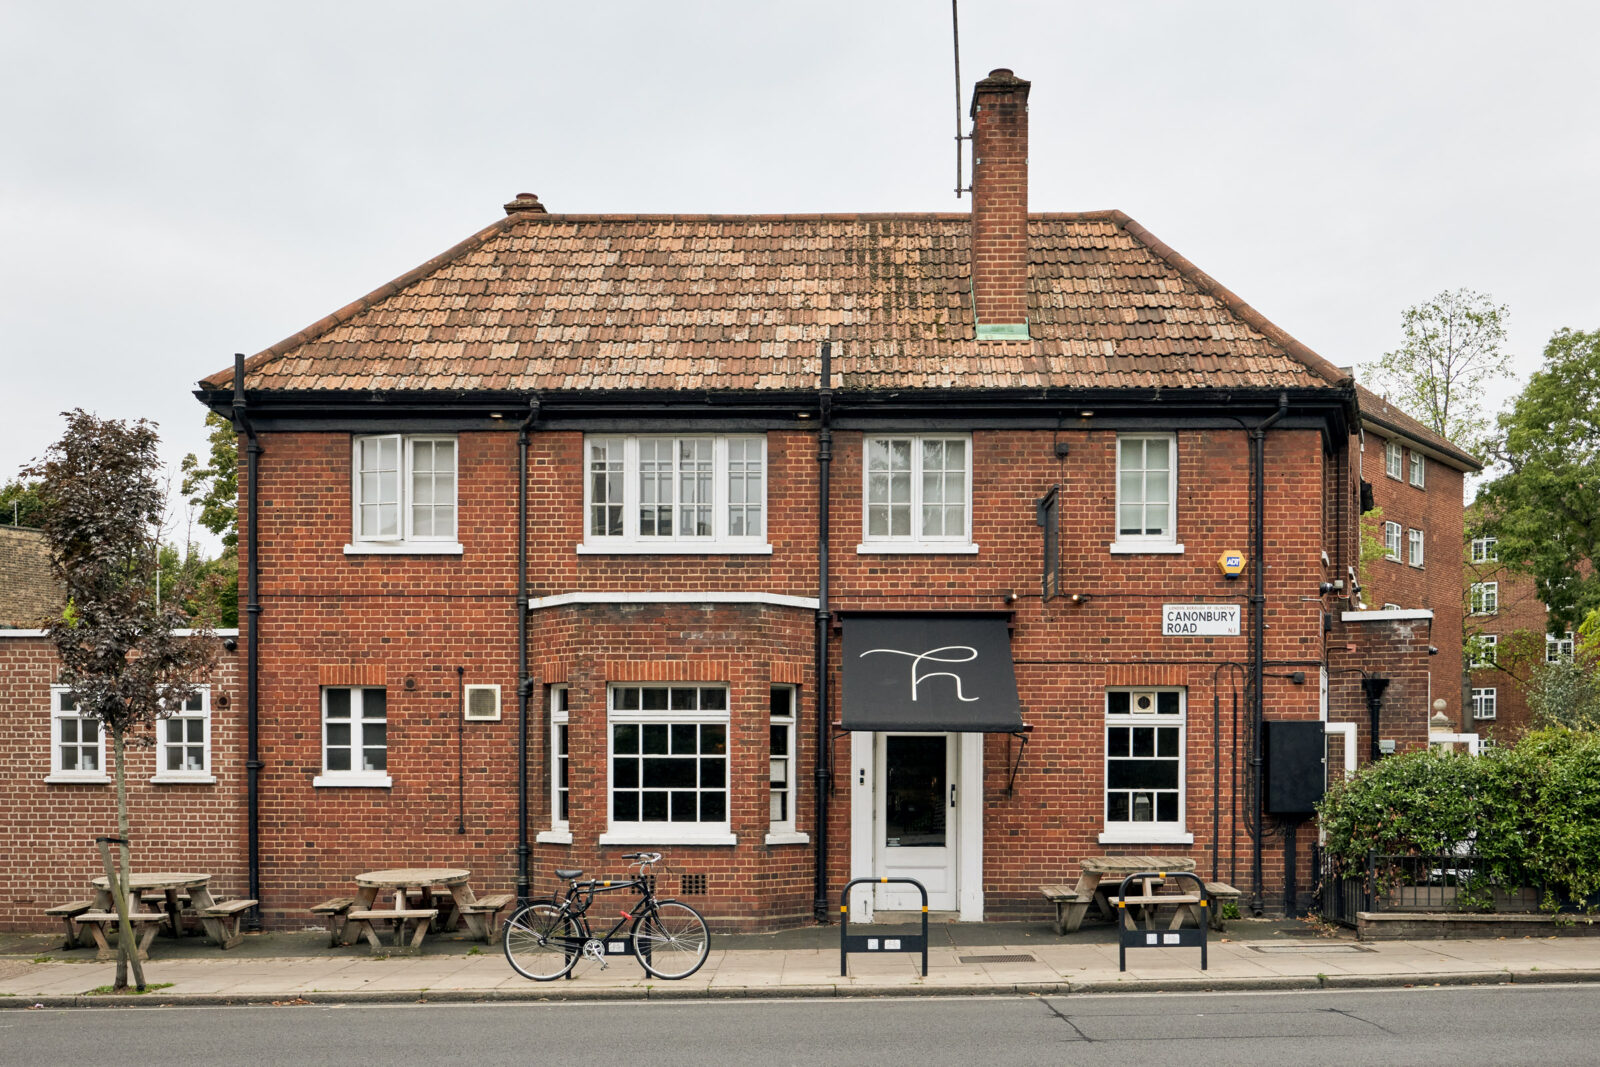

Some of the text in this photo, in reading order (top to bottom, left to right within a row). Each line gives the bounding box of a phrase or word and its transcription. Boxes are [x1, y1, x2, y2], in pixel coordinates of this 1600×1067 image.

[1226, 558, 1240, 566] ADT
[1167, 611, 1236, 622] CANONBURY
[1167, 623, 1198, 633] ROAD
